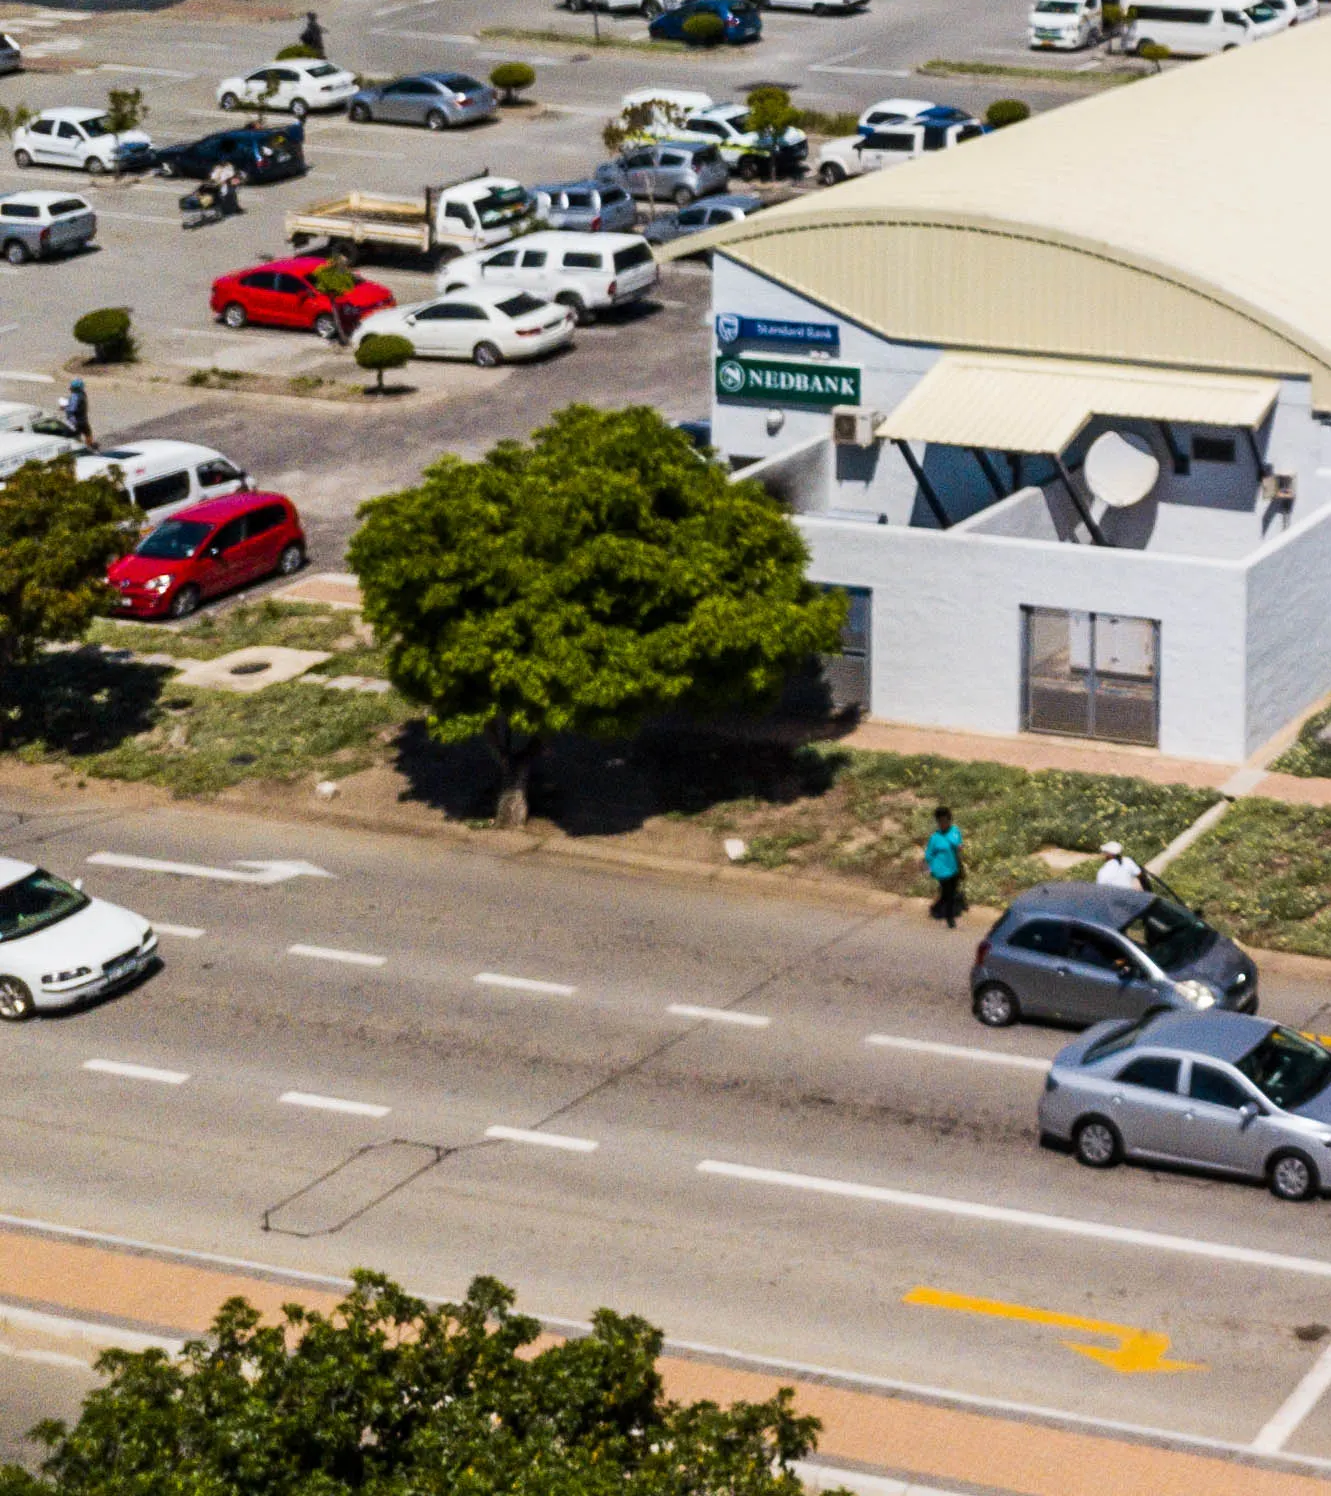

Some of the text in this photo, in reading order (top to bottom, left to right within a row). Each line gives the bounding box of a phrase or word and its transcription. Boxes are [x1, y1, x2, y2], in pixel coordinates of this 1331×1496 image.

[756, 324, 832, 340] Standard Bank
[749, 369, 856, 396] NEDBANK
